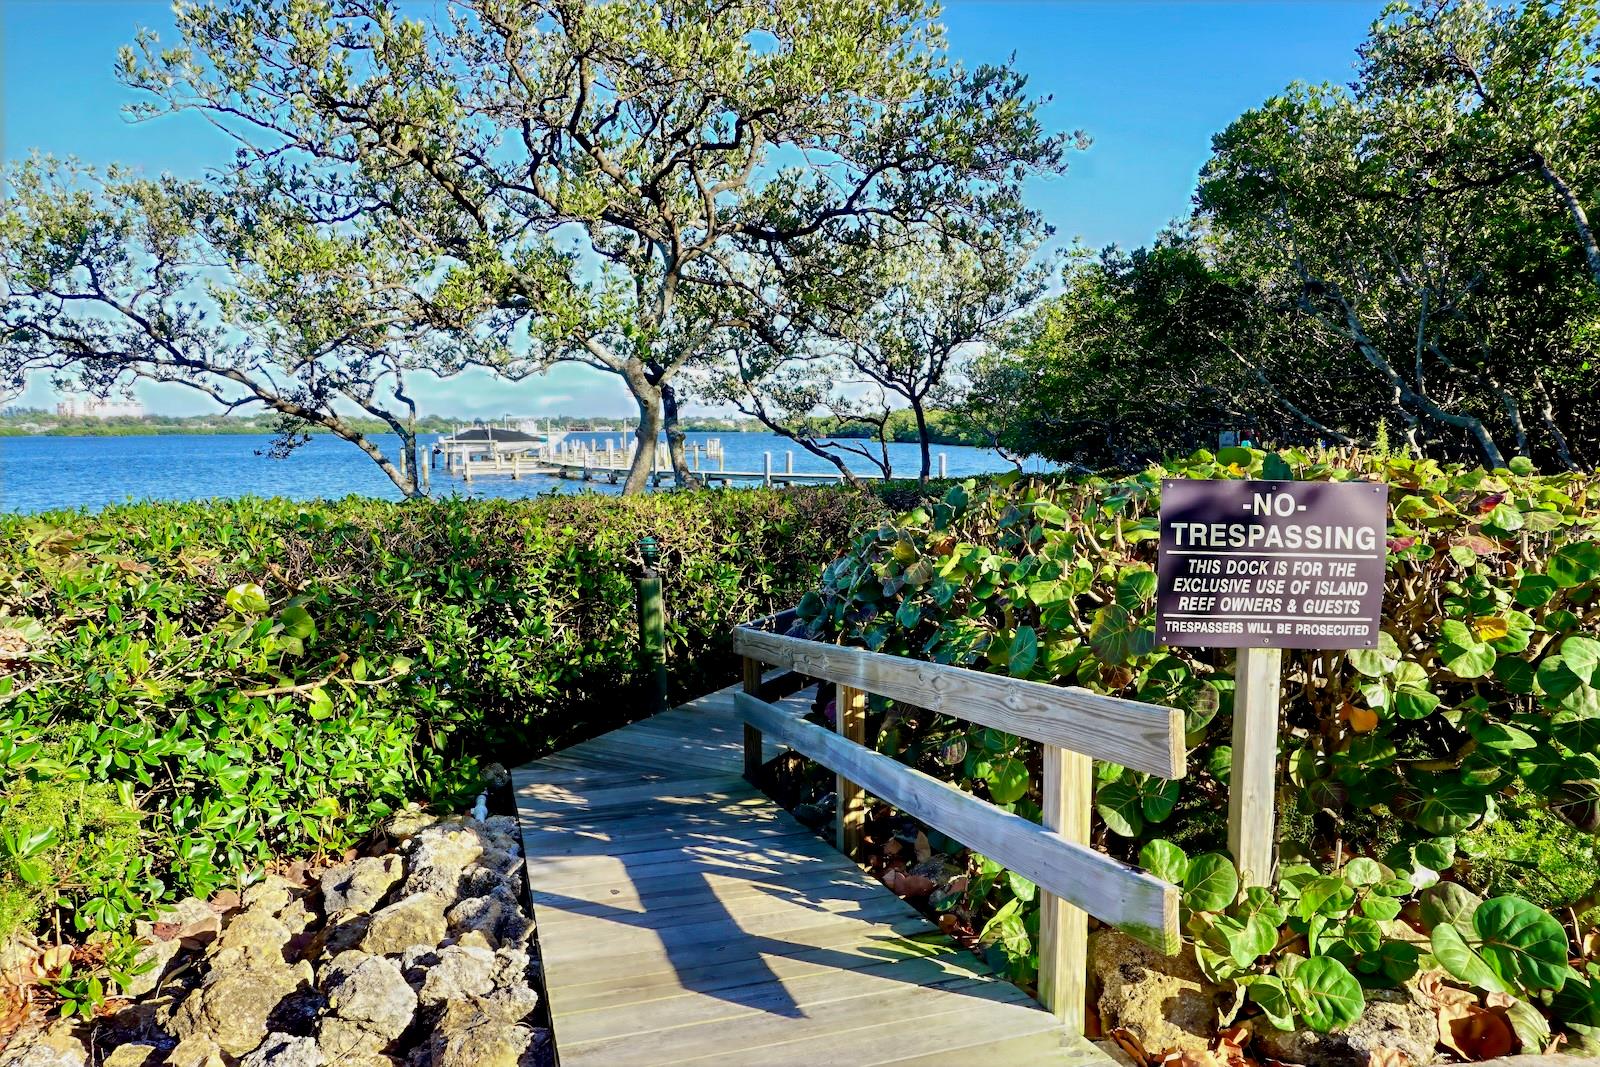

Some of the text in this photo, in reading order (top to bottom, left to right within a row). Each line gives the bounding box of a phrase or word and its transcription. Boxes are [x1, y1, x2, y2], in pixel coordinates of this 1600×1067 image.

[1243, 493, 1306, 516] -NO-
[1171, 522, 1376, 550] TRESPASSING
[1189, 560, 1356, 577] THIS DOCK IS FOR THE
[1174, 578, 1368, 595] EXCLUSIVE USE OF ISLAND
[1179, 597, 1360, 614] REEF OWNERS & GUESTS
[1166, 621, 1369, 636] TRESPASSERS WILL BE PROSECUTED
